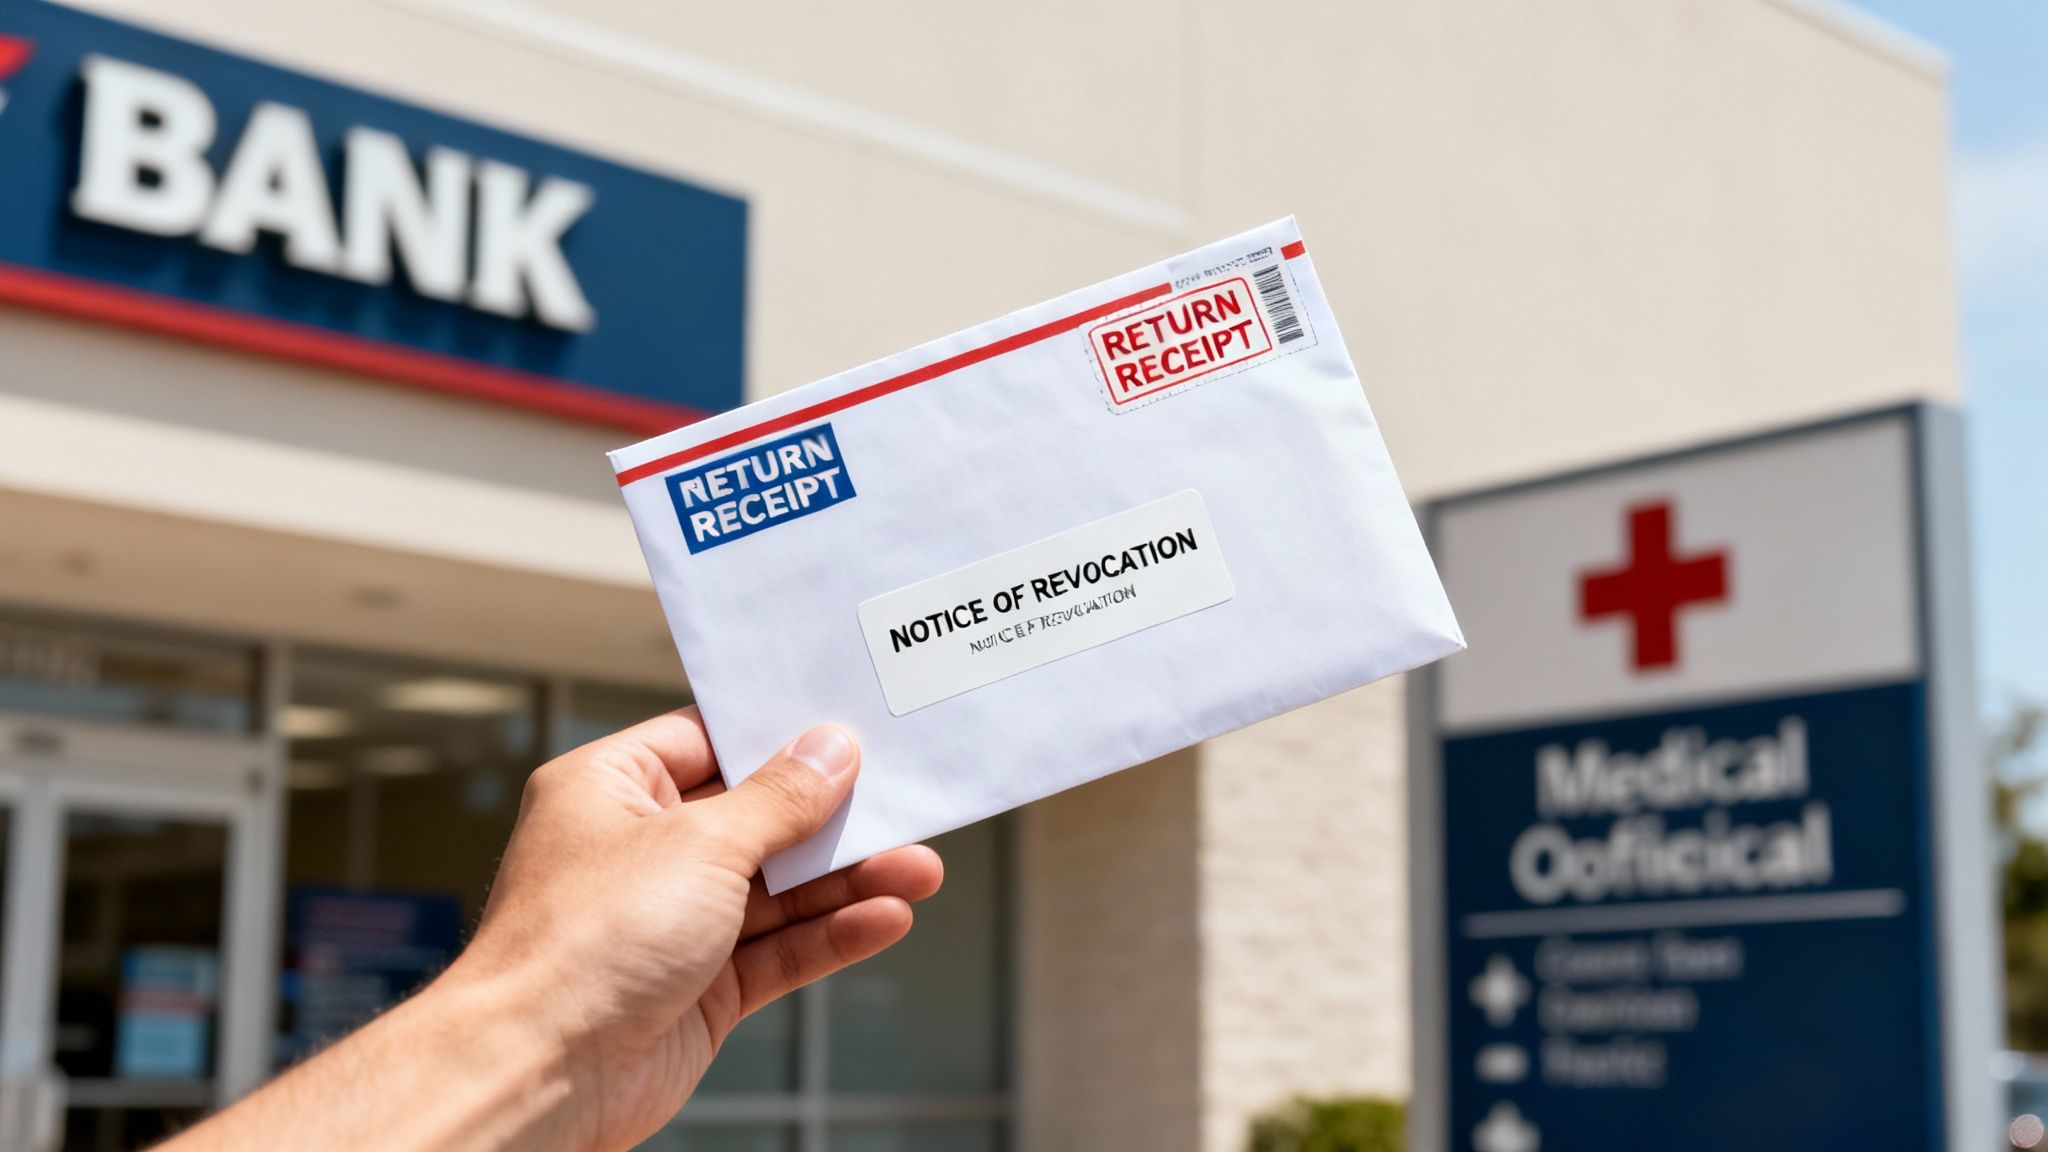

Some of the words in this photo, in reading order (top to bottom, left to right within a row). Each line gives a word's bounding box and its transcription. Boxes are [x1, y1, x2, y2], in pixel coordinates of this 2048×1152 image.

[76, 56, 594, 331] BANK
[1101, 290, 1242, 361] RETURN
[1114, 319, 1252, 393] RECEIPT
[689, 466, 840, 542] RECEIPT
[889, 598, 988, 653] NOTICE
[993, 583, 1025, 614] OF
[1030, 527, 1198, 603] REVOCATION
[1537, 716, 1808, 817] Medical
